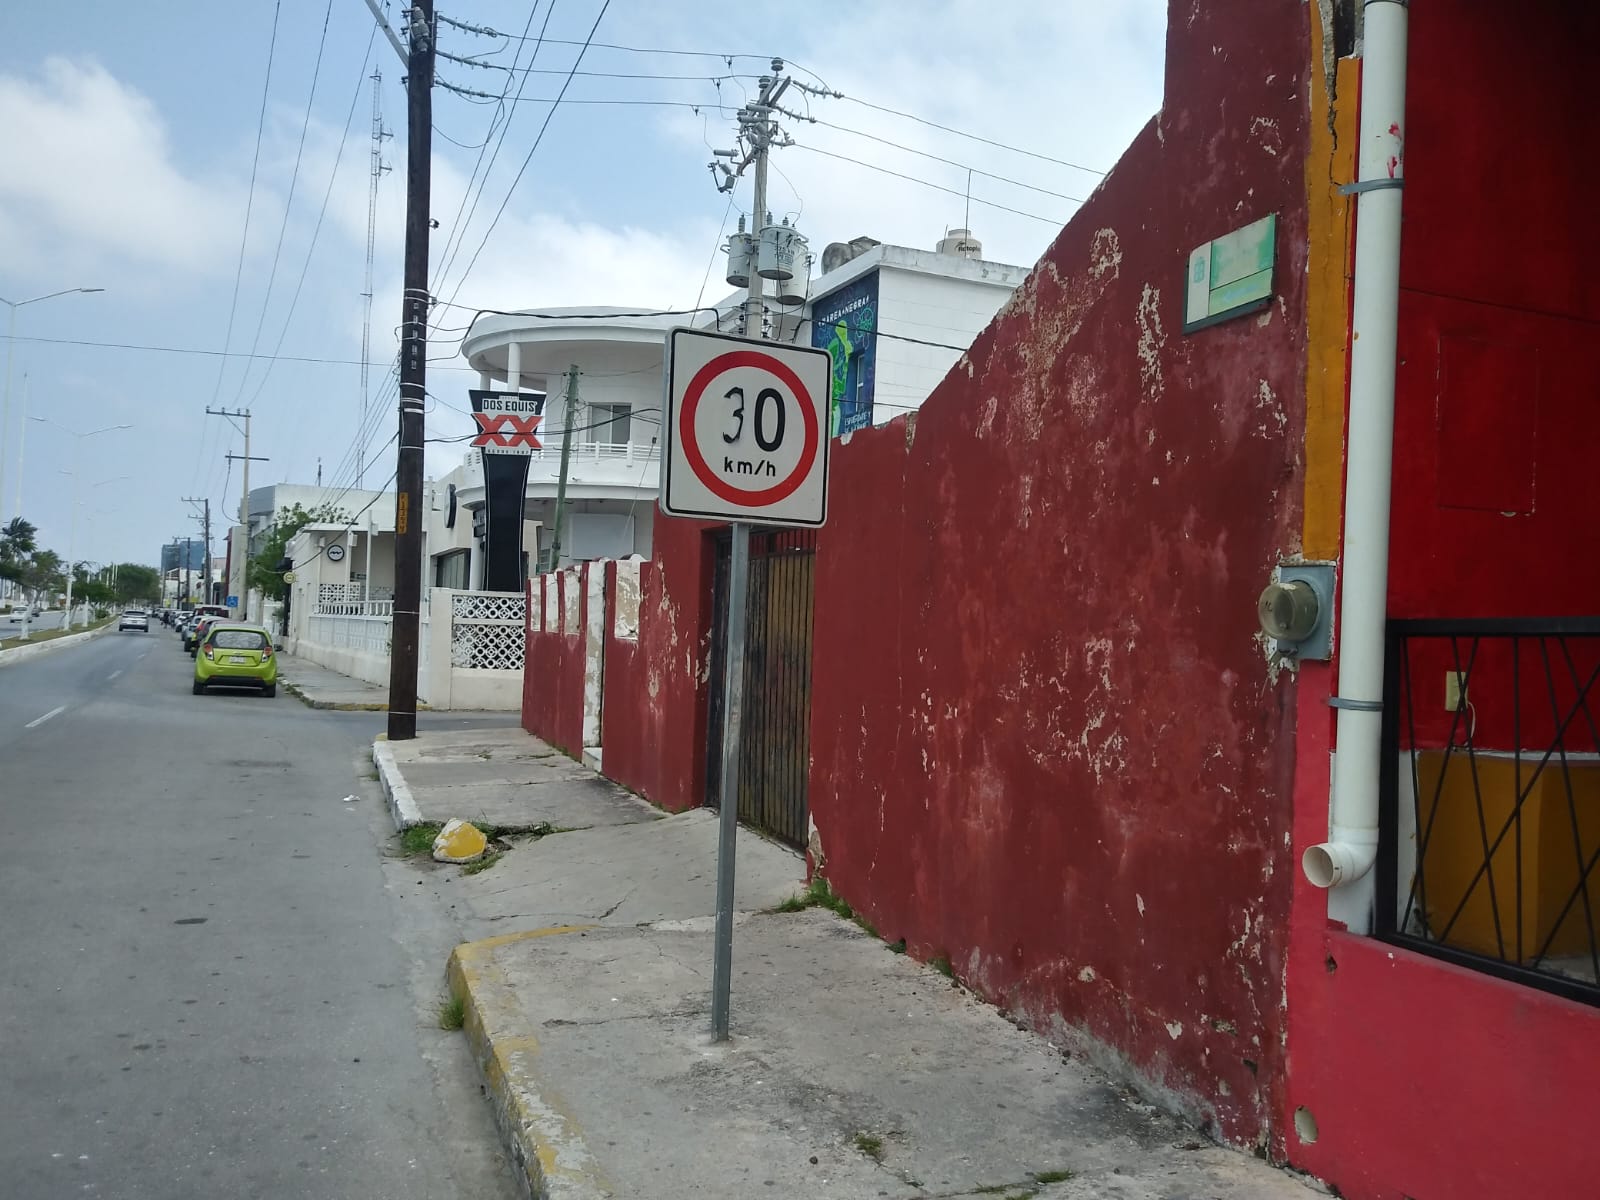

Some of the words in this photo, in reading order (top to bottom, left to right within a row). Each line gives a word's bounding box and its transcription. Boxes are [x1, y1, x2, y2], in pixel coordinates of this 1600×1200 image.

[483, 400, 503, 411] DOS
[505, 401, 535, 412] EQUIS
[723, 386, 786, 452] 30
[471, 413, 544, 448] XX
[724, 456, 776, 477] km/h
